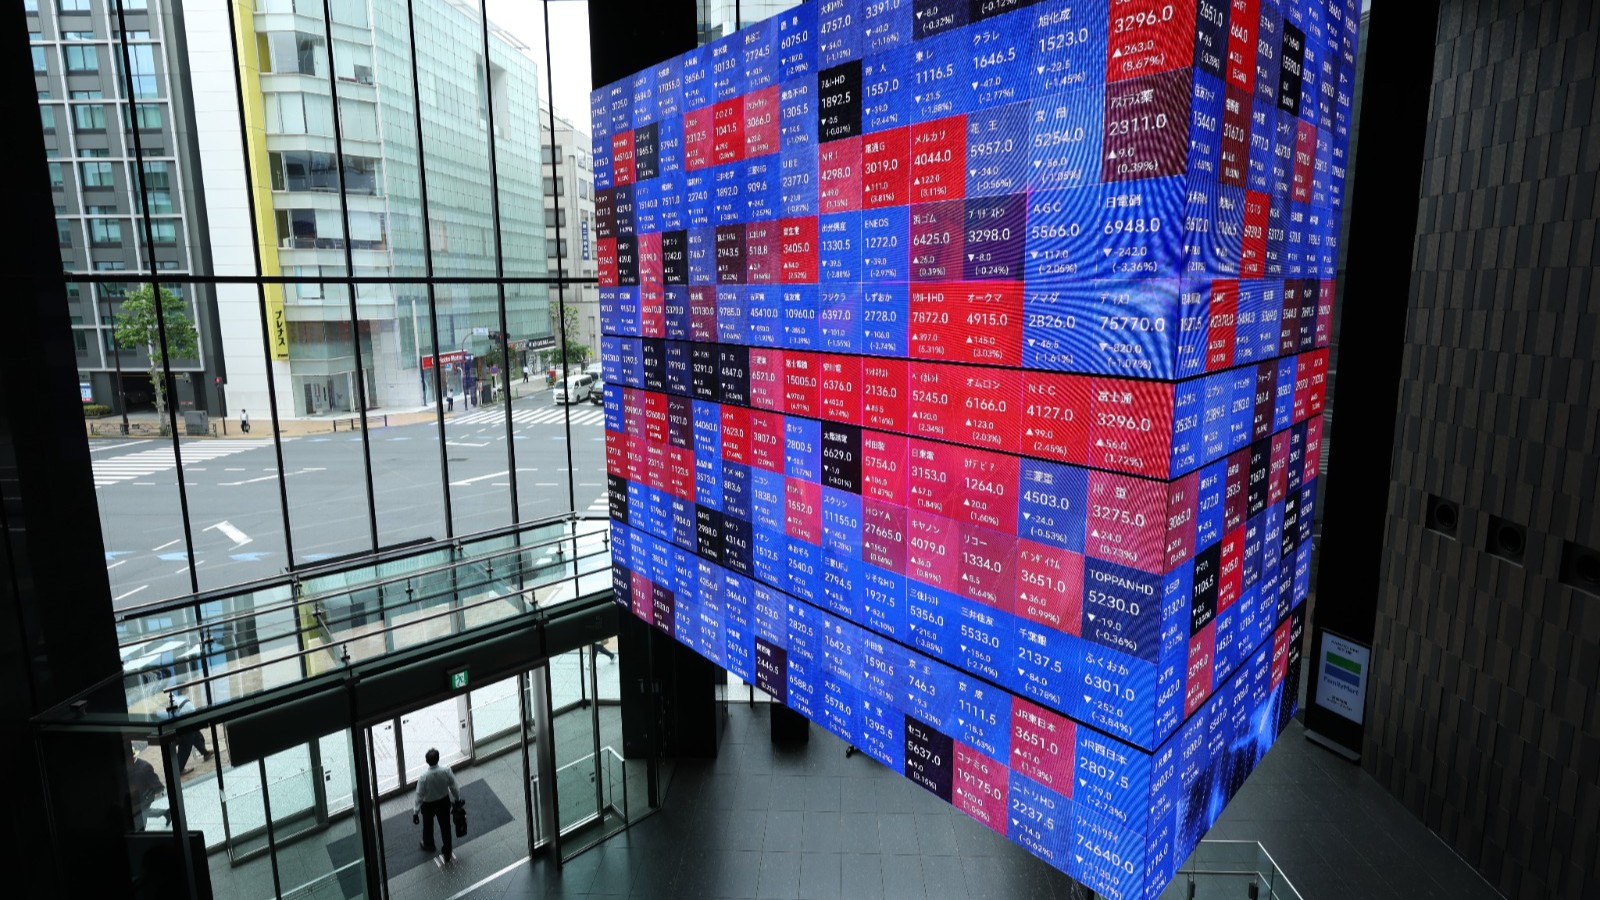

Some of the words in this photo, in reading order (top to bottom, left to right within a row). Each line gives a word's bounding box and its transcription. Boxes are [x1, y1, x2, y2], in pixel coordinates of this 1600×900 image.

[866, 0, 899, 19] 3391.0
[1038, 8, 1071, 27] 旭化成
[1200, 1, 1222, 27] 2651.0
[821, 15, 850, 34] 4757.0
[1114, 5, 1173, 34] 3296.0
[782, 30, 808, 49] 6075.0
[973, 32, 999, 46] クラレ
[1039, 28, 1088, 52] 1523.0
[1231, 24, 1247, 43] 664.0
[746, 45, 769, 62] 2724.5
[1124, 39, 1154, 56] 263.0
[915, 51, 933, 63] 東レ
[973, 47, 1015, 69] 1646.5
[1123, 53, 1165, 73] (8.67%)
[714, 58, 735, 74] 3013.0
[916, 64, 953, 84] 1116.5
[866, 78, 899, 97] 1557.0
[822, 92, 850, 108] 1892.5
[783, 103, 808, 119] 1305.5
[716, 122, 736, 136] 1041.5
[747, 114, 770, 128] 3066.0
[1109, 113, 1167, 136] 2311.0
[915, 131, 945, 144] メルカリ
[1035, 128, 1083, 148] 5254.0
[971, 140, 1012, 157] 5957.0
[1118, 147, 1135, 158] 9.0
[914, 149, 951, 166] 4044.0
[822, 167, 850, 181] 4298.0
[865, 159, 897, 174] 3019.0
[1118, 161, 1158, 174] (0.39%)
[748, 181, 767, 192] 909.6
[783, 174, 808, 187] 2377.0
[1106, 194, 1141, 209] 日電硝
[865, 218, 889, 228] ENEOS
[1032, 223, 1080, 239] 5566.0
[1104, 217, 1160, 234] 6948.0
[865, 236, 897, 248] 1272.0
[914, 233, 949, 245] 6425.0
[969, 228, 1010, 243] 3298.0
[784, 242, 809, 253] 3405.0
[823, 239, 850, 250] 1330.5
[1114, 246, 1147, 257] -242.0
[976, 253, 991, 261] -8.0
[976, 266, 1008, 276] (-0.24%)
[1112, 261, 1157, 272] (-3.36%)
[823, 293, 846, 301] フジクラ
[865, 293, 892, 302] しずおか
[967, 293, 1002, 303] オークマ
[751, 308, 778, 318] 45410.0
[785, 309, 814, 319] 10960.0
[822, 310, 850, 320] 6397.0
[865, 311, 896, 322] 2728.0
[913, 312, 948, 324] 7872.0
[967, 314, 1007, 326] 4915.0
[1029, 315, 1076, 328] 2826.0
[1101, 317, 1165, 332] 75770.0
[1108, 343, 1142, 354] -820.0
[722, 368, 742, 378] 4847.0
[752, 372, 775, 382] 6521.0
[786, 375, 816, 387] 15005.0
[824, 381, 851, 392] 6376.0
[865, 385, 896, 397] 2136.0
[967, 379, 1000, 389] オムロン
[913, 390, 947, 404] 5245.0
[966, 397, 1006, 412] 6166.0
[1098, 390, 1132, 405] 富士通
[1027, 405, 1073, 422] 4127.0
[974, 421, 993, 429] 123.0
[1097, 413, 1151, 432] 3296.0
[754, 432, 776, 445] 3807.0
[1034, 429, 1053, 439] 99.0
[787, 439, 811, 453] 2800.5
[1106, 439, 1127, 450] 56.0
[824, 448, 851, 462] 6629.0
[1105, 454, 1143, 468] (1.72%)
[865, 457, 896, 471] 5754.0
[912, 466, 946, 483] 3153.0
[965, 477, 1004, 495] 1264.0
[755, 489, 777, 504] 1838.0
[972, 499, 986, 510] 20.0
[1024, 490, 1069, 510] 4503.0
[825, 511, 856, 528] 11155.0
[1031, 515, 1053, 526] -24.0
[1092, 505, 1144, 527] 3275.0
[1168, 508, 1190, 530] 3065.0
[865, 523, 901, 542] 27665.0
[964, 535, 987, 546] リコー
[911, 537, 945, 555] 4079.0
[788, 558, 812, 575] 2540.0
[964, 552, 1001, 573] 1334.0
[825, 572, 851, 590] 2794.5
[1021, 570, 1065, 592] 3651.0
[1089, 569, 1153, 595] TOPPANHD
[866, 588, 894, 607] 1927.5
[1029, 594, 1046, 606] 36.0
[1088, 591, 1139, 616] 5230.0
[910, 605, 943, 626] 5356.0
[962, 606, 994, 626] 三井住友
[1163, 595, 1185, 621] 3132.0
[789, 619, 813, 636] 2820.5
[1097, 618, 1121, 631] -19.0
[961, 625, 999, 648] 5533.0
[1096, 630, 1137, 651] (-0.36%)
[825, 636, 851, 655] 1642.5
[757, 657, 778, 675] 2446.5
[865, 655, 893, 676] 1590.5
[1018, 647, 1062, 673] 2137.5
[1086, 652, 1128, 676] ふくおか
[790, 676, 813, 694] 6588.0
[909, 675, 935, 696] 746.3
[1026, 672, 1047, 686] -84.0
[1085, 673, 1134, 701] 6301.0
[1323, 675, 1359, 696] FamilyMart
[1158, 679, 1180, 707] 6642.0
[825, 695, 851, 715] 5578.0
[959, 700, 996, 725] 1111.5
[1093, 700, 1123, 718] -252.0
[865, 716, 892, 739] 1395.5
[1016, 709, 1056, 732] JR東日本
[1092, 712, 1132, 736] (-3.84%)
[908, 725, 928, 742] セコム
[1015, 726, 1057, 755] 3651.0
[908, 741, 940, 766] 5637.0
[1023, 751, 1039, 765] 41.0
[1081, 739, 1128, 765] JR西日本
[958, 752, 988, 774] コナミG
[1080, 756, 1128, 789] 2807.5
[958, 768, 1001, 799] 19175.0
[1088, 784, 1112, 800] -79.0
[1013, 781, 1055, 809] ニトリHD
[1012, 800, 1055, 830] 2237.5
[1087, 794, 1126, 822] (-2.73%)
[1020, 824, 1040, 839] -14.0
[1076, 834, 1133, 874] 74640.0
